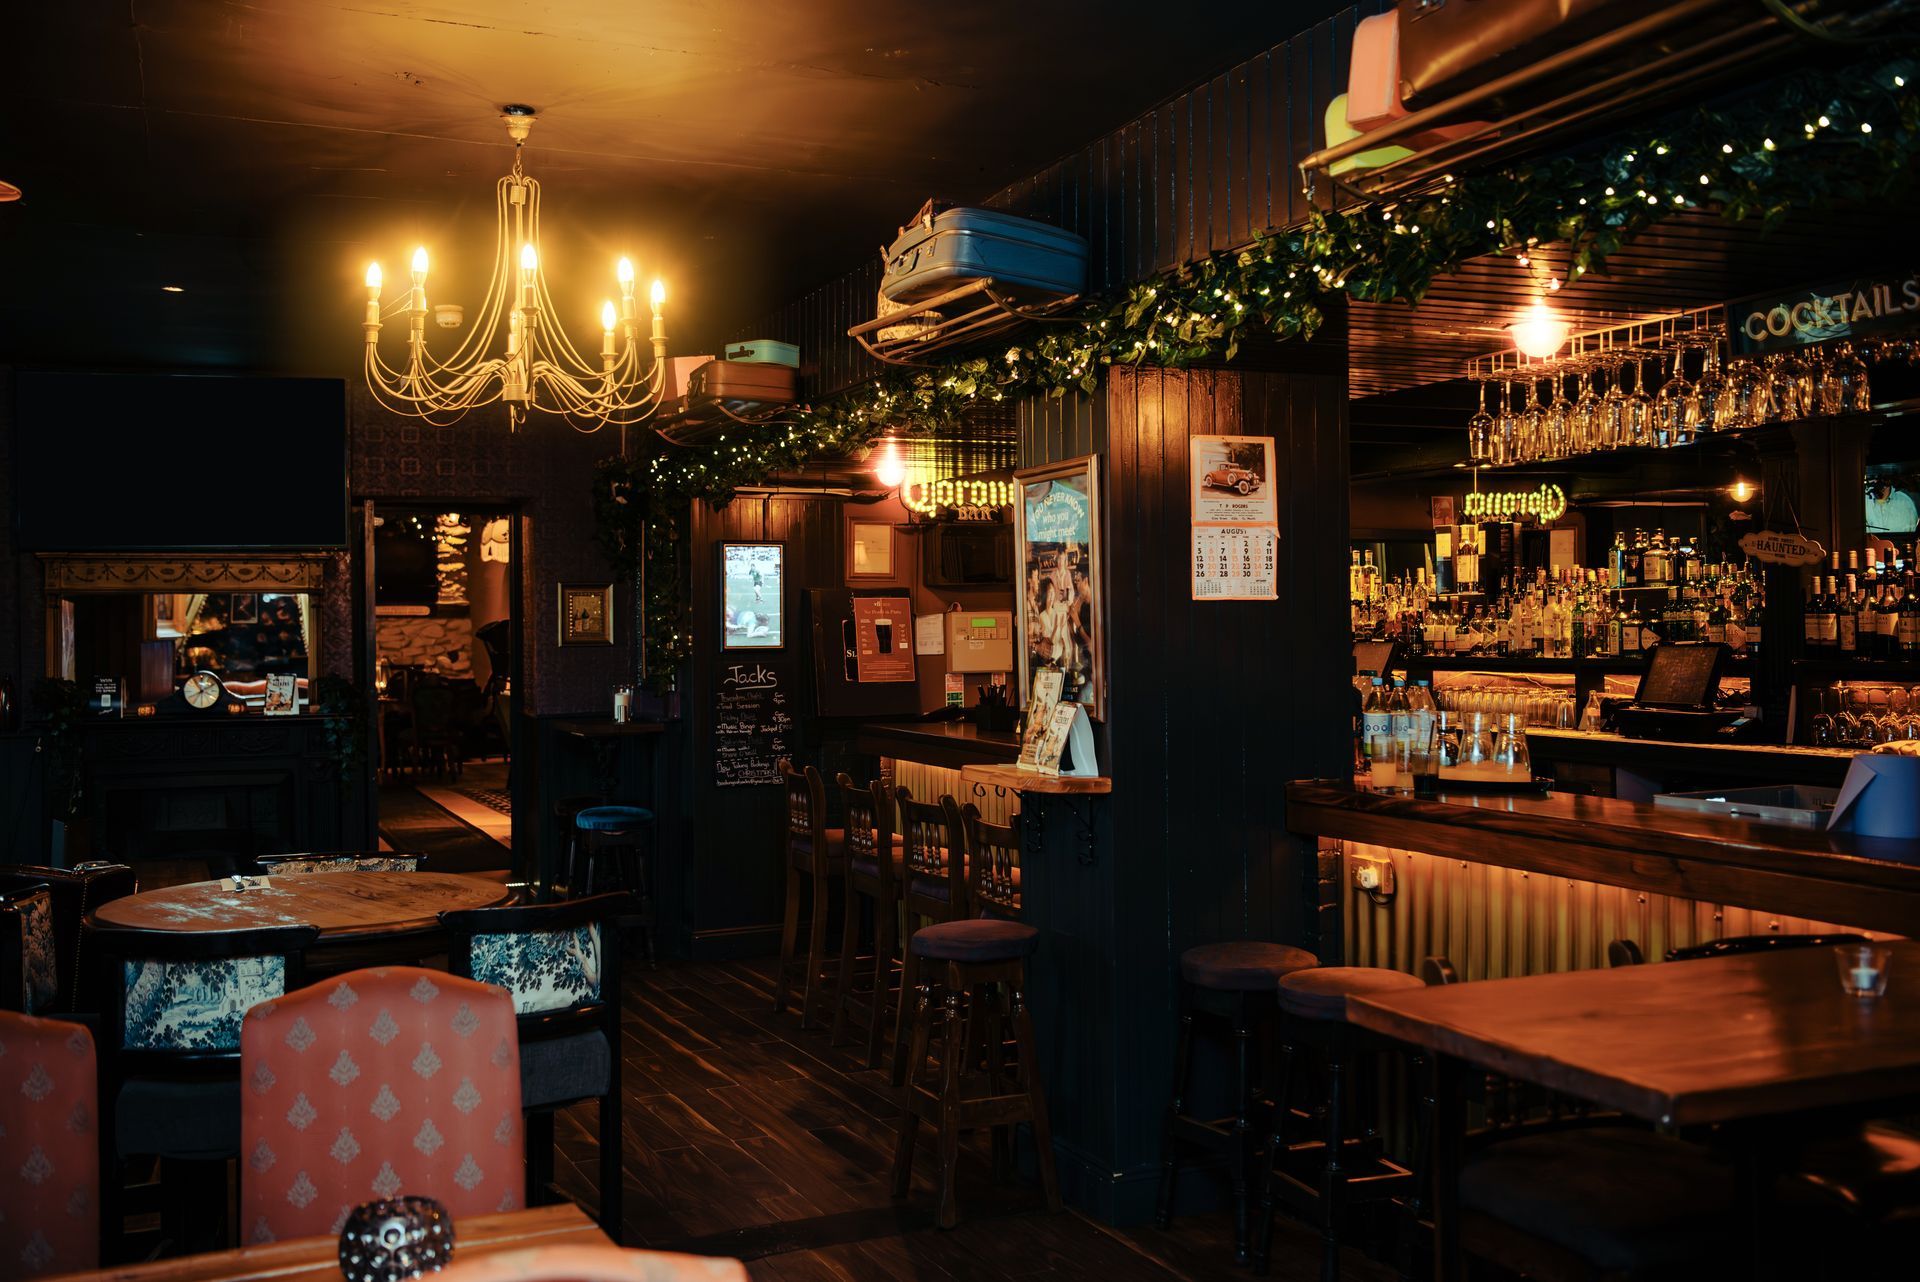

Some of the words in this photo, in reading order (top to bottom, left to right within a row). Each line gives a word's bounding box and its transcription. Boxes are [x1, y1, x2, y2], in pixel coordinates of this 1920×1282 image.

[1745, 280, 1920, 342] COCKTAILS
[1043, 492, 1065, 507] NEVER
[1065, 494, 1085, 518] KNOW
[1757, 540, 1806, 555] HAUNTED
[723, 664, 778, 690] Jacks
[736, 701, 760, 710] Session
[738, 721, 756, 731] Bingo
